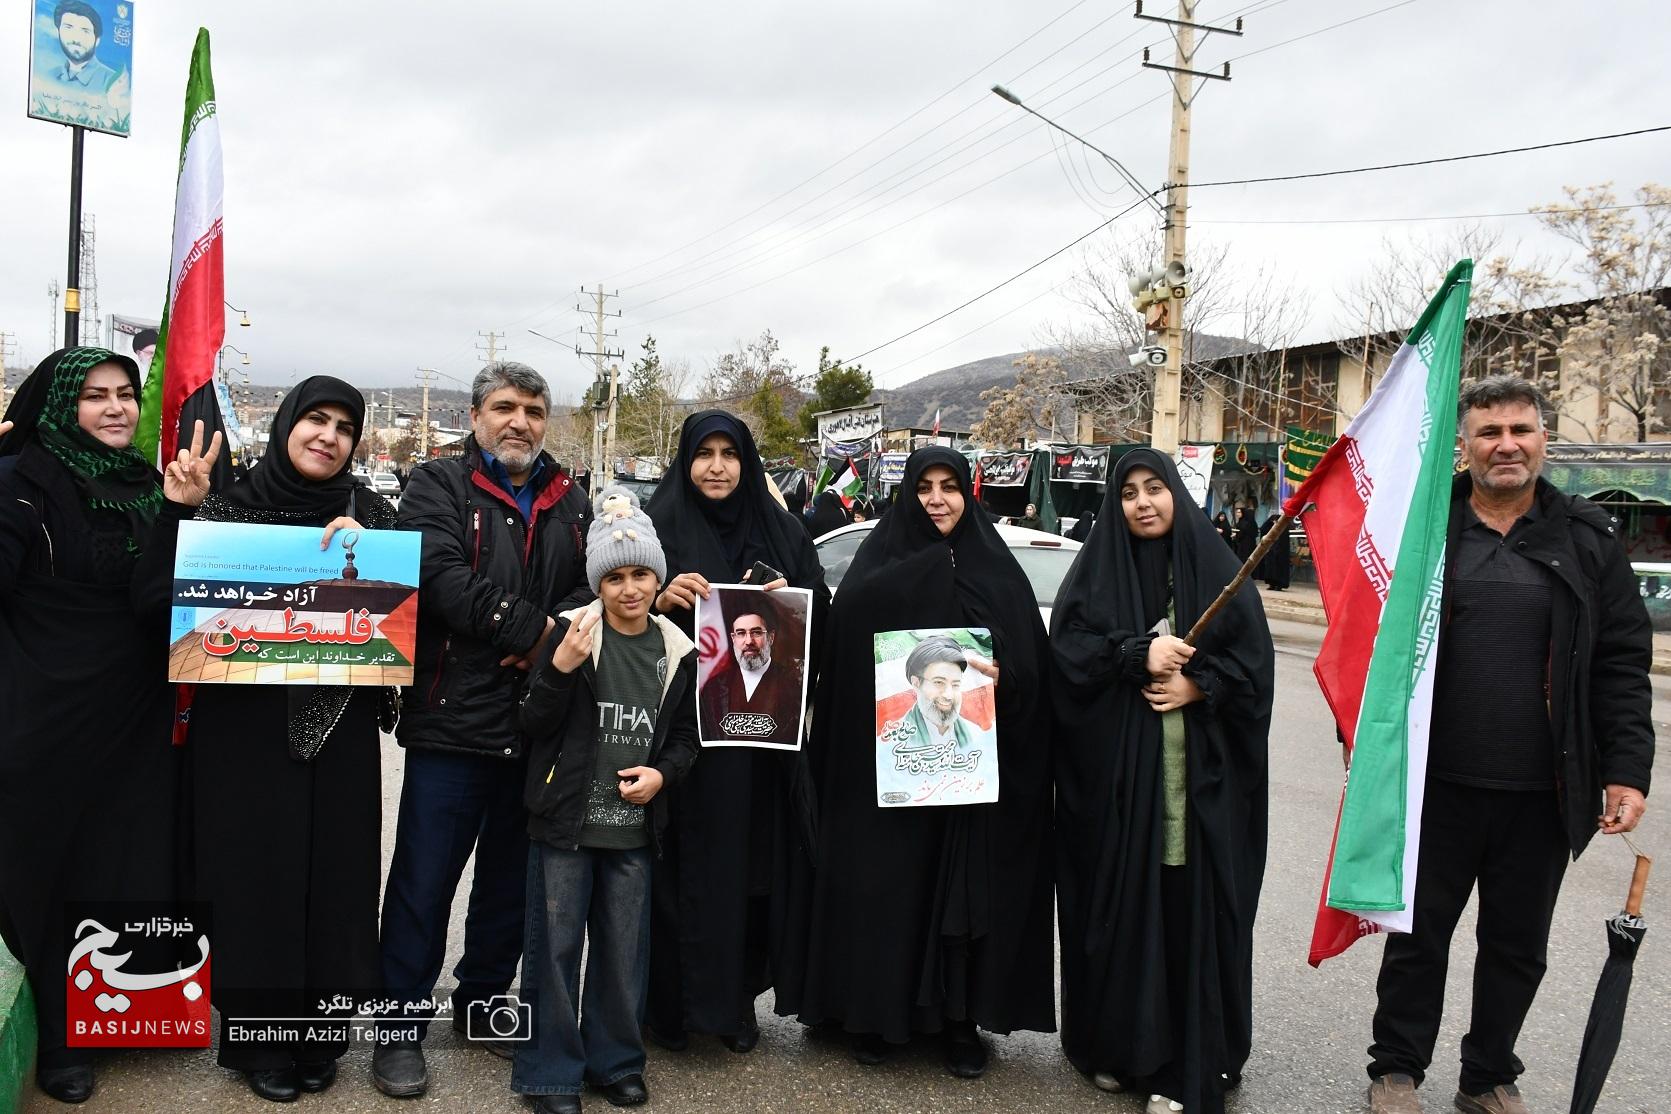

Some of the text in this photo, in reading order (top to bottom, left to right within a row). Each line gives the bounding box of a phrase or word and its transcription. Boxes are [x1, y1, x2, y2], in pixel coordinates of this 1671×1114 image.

[183, 560, 339, 575] God is honored that Palestine will be freed
[213, 585, 278, 606] خواهد
[283, 585, 319, 606] آزاد
[202, 606, 374, 656] فلسطین
[257, 648, 396, 665] تقدیر خداوند این است که
[597, 701, 657, 734] TIHA
[598, 733, 652, 747] IRWAY
